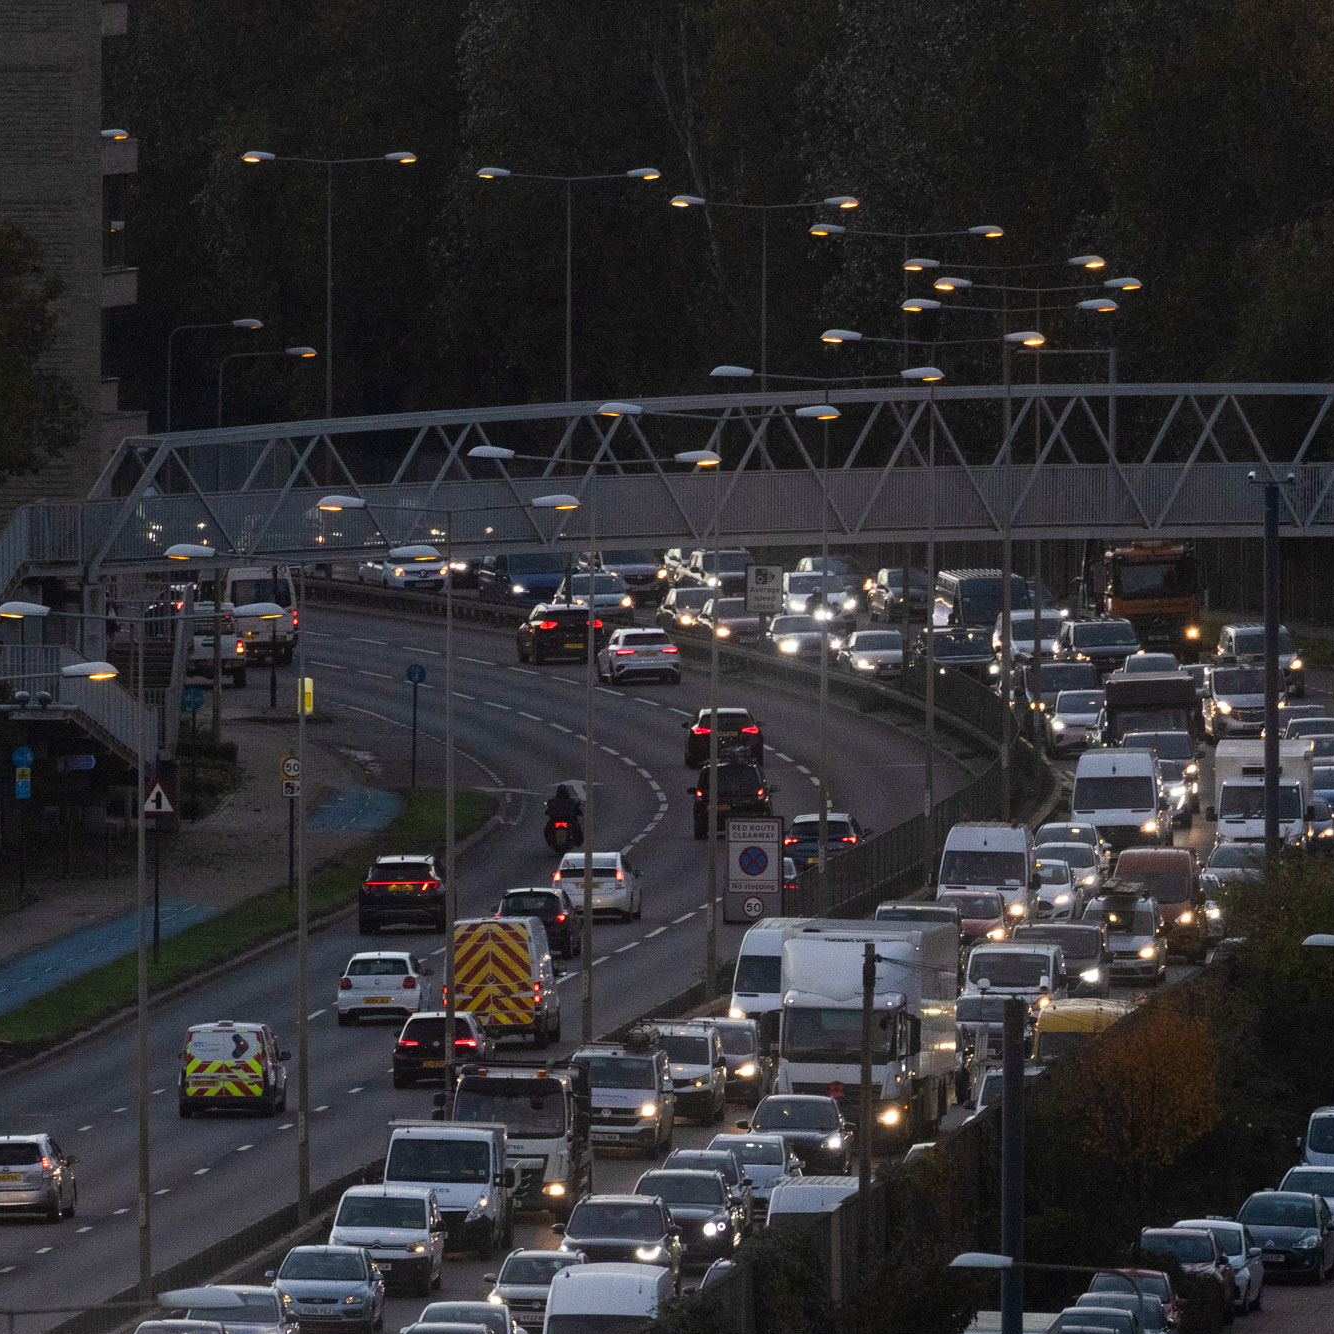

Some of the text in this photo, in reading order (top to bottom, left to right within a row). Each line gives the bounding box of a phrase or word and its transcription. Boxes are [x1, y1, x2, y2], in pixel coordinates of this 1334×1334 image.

[285, 763, 300, 773] 50
[731, 824, 776, 832] RED ROUTE
[744, 883, 775, 891] stopping
[746, 902, 762, 913] 50
